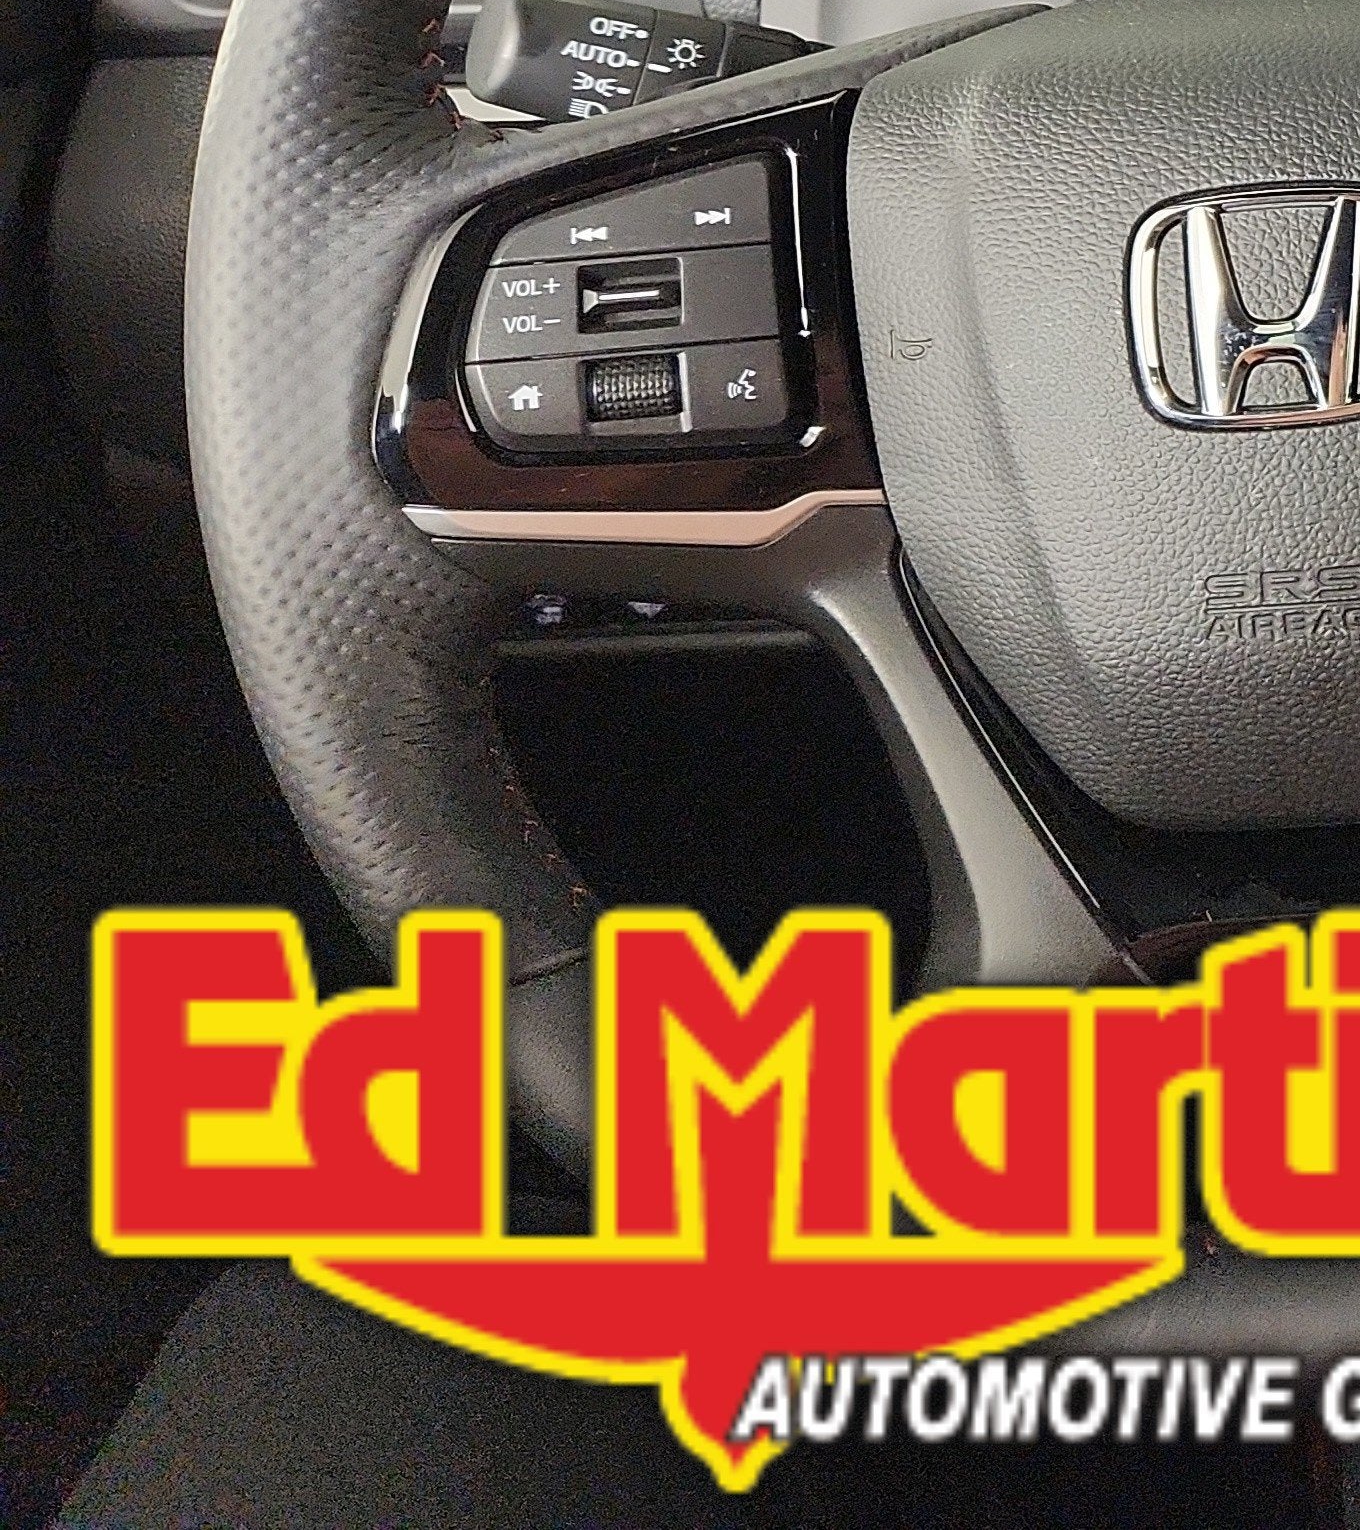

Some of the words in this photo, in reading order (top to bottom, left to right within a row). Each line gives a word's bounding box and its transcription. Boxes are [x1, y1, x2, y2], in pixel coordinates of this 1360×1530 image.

[589, 16, 638, 41] OFF
[560, 39, 628, 68] AUTO
[502, 277, 561, 298] VOL+
